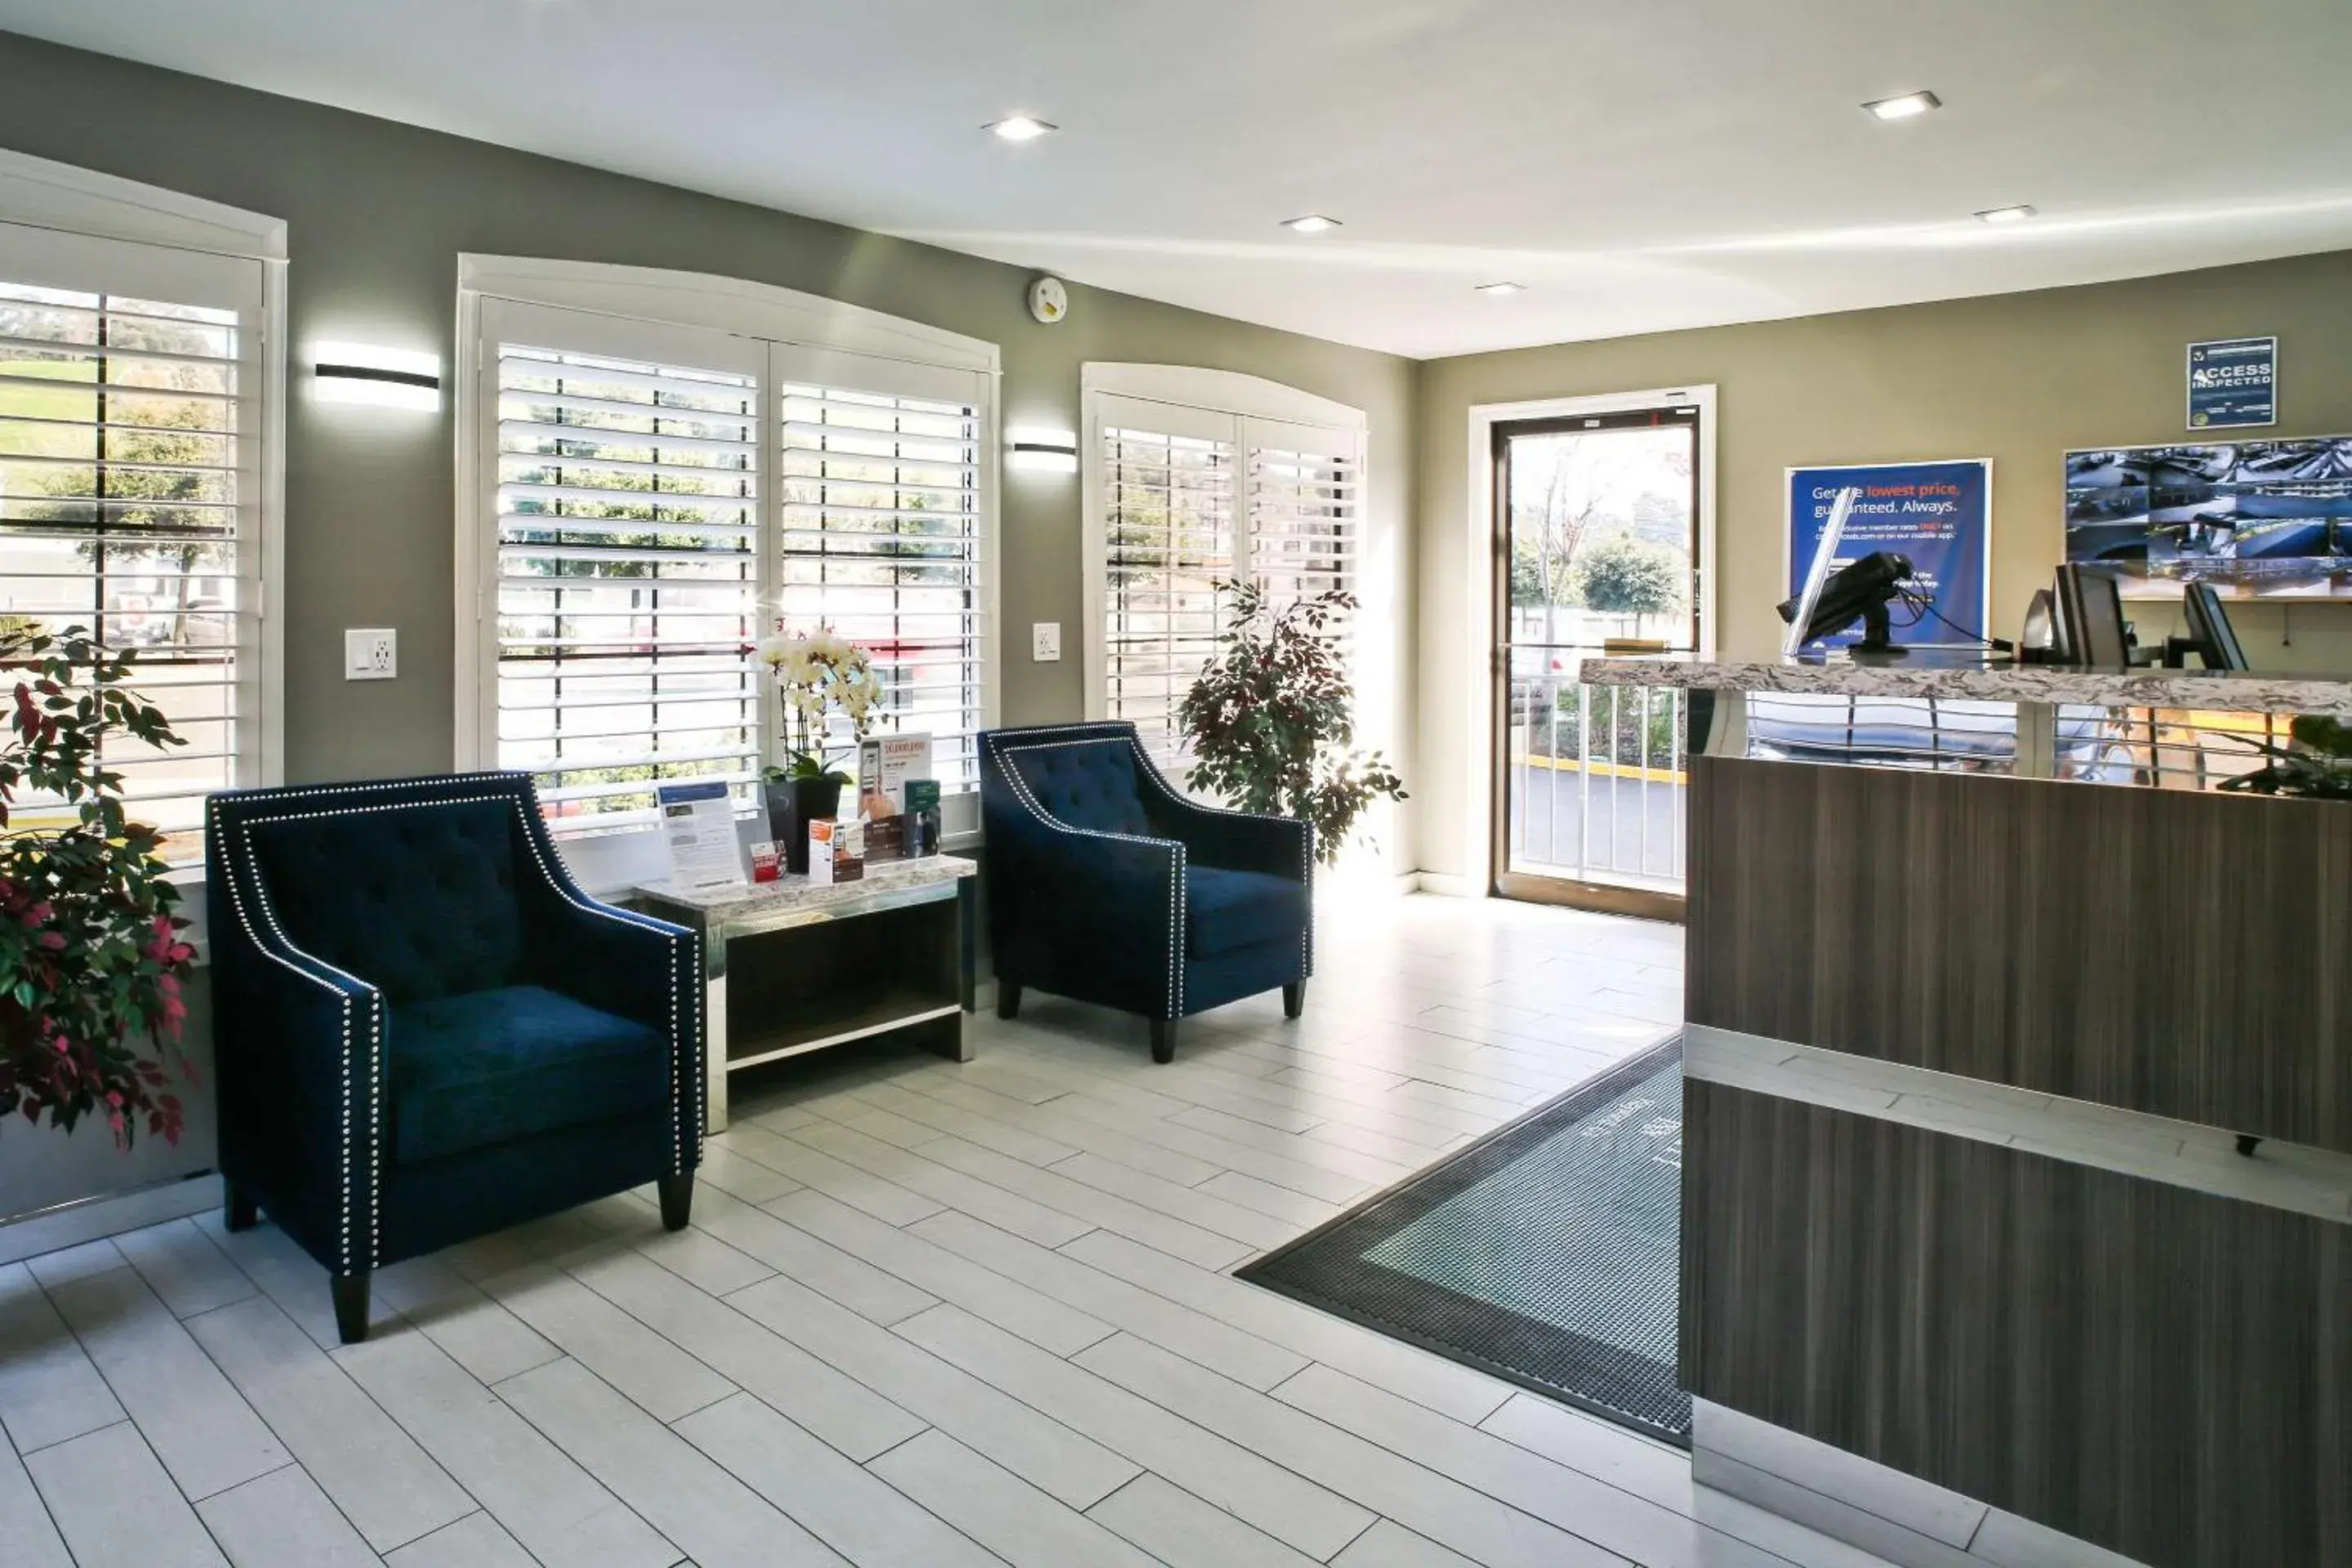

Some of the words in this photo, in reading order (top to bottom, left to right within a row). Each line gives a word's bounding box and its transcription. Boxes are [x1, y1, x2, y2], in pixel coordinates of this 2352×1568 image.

[2194, 363, 2271, 381] ACCESS
[2192, 375, 2271, 389] INSPECTED
[1812, 487, 1837, 500] Get
[1867, 484, 1915, 497] lowest
[1814, 501, 1898, 519] guanteed.
[1902, 499, 1958, 515] Always.
